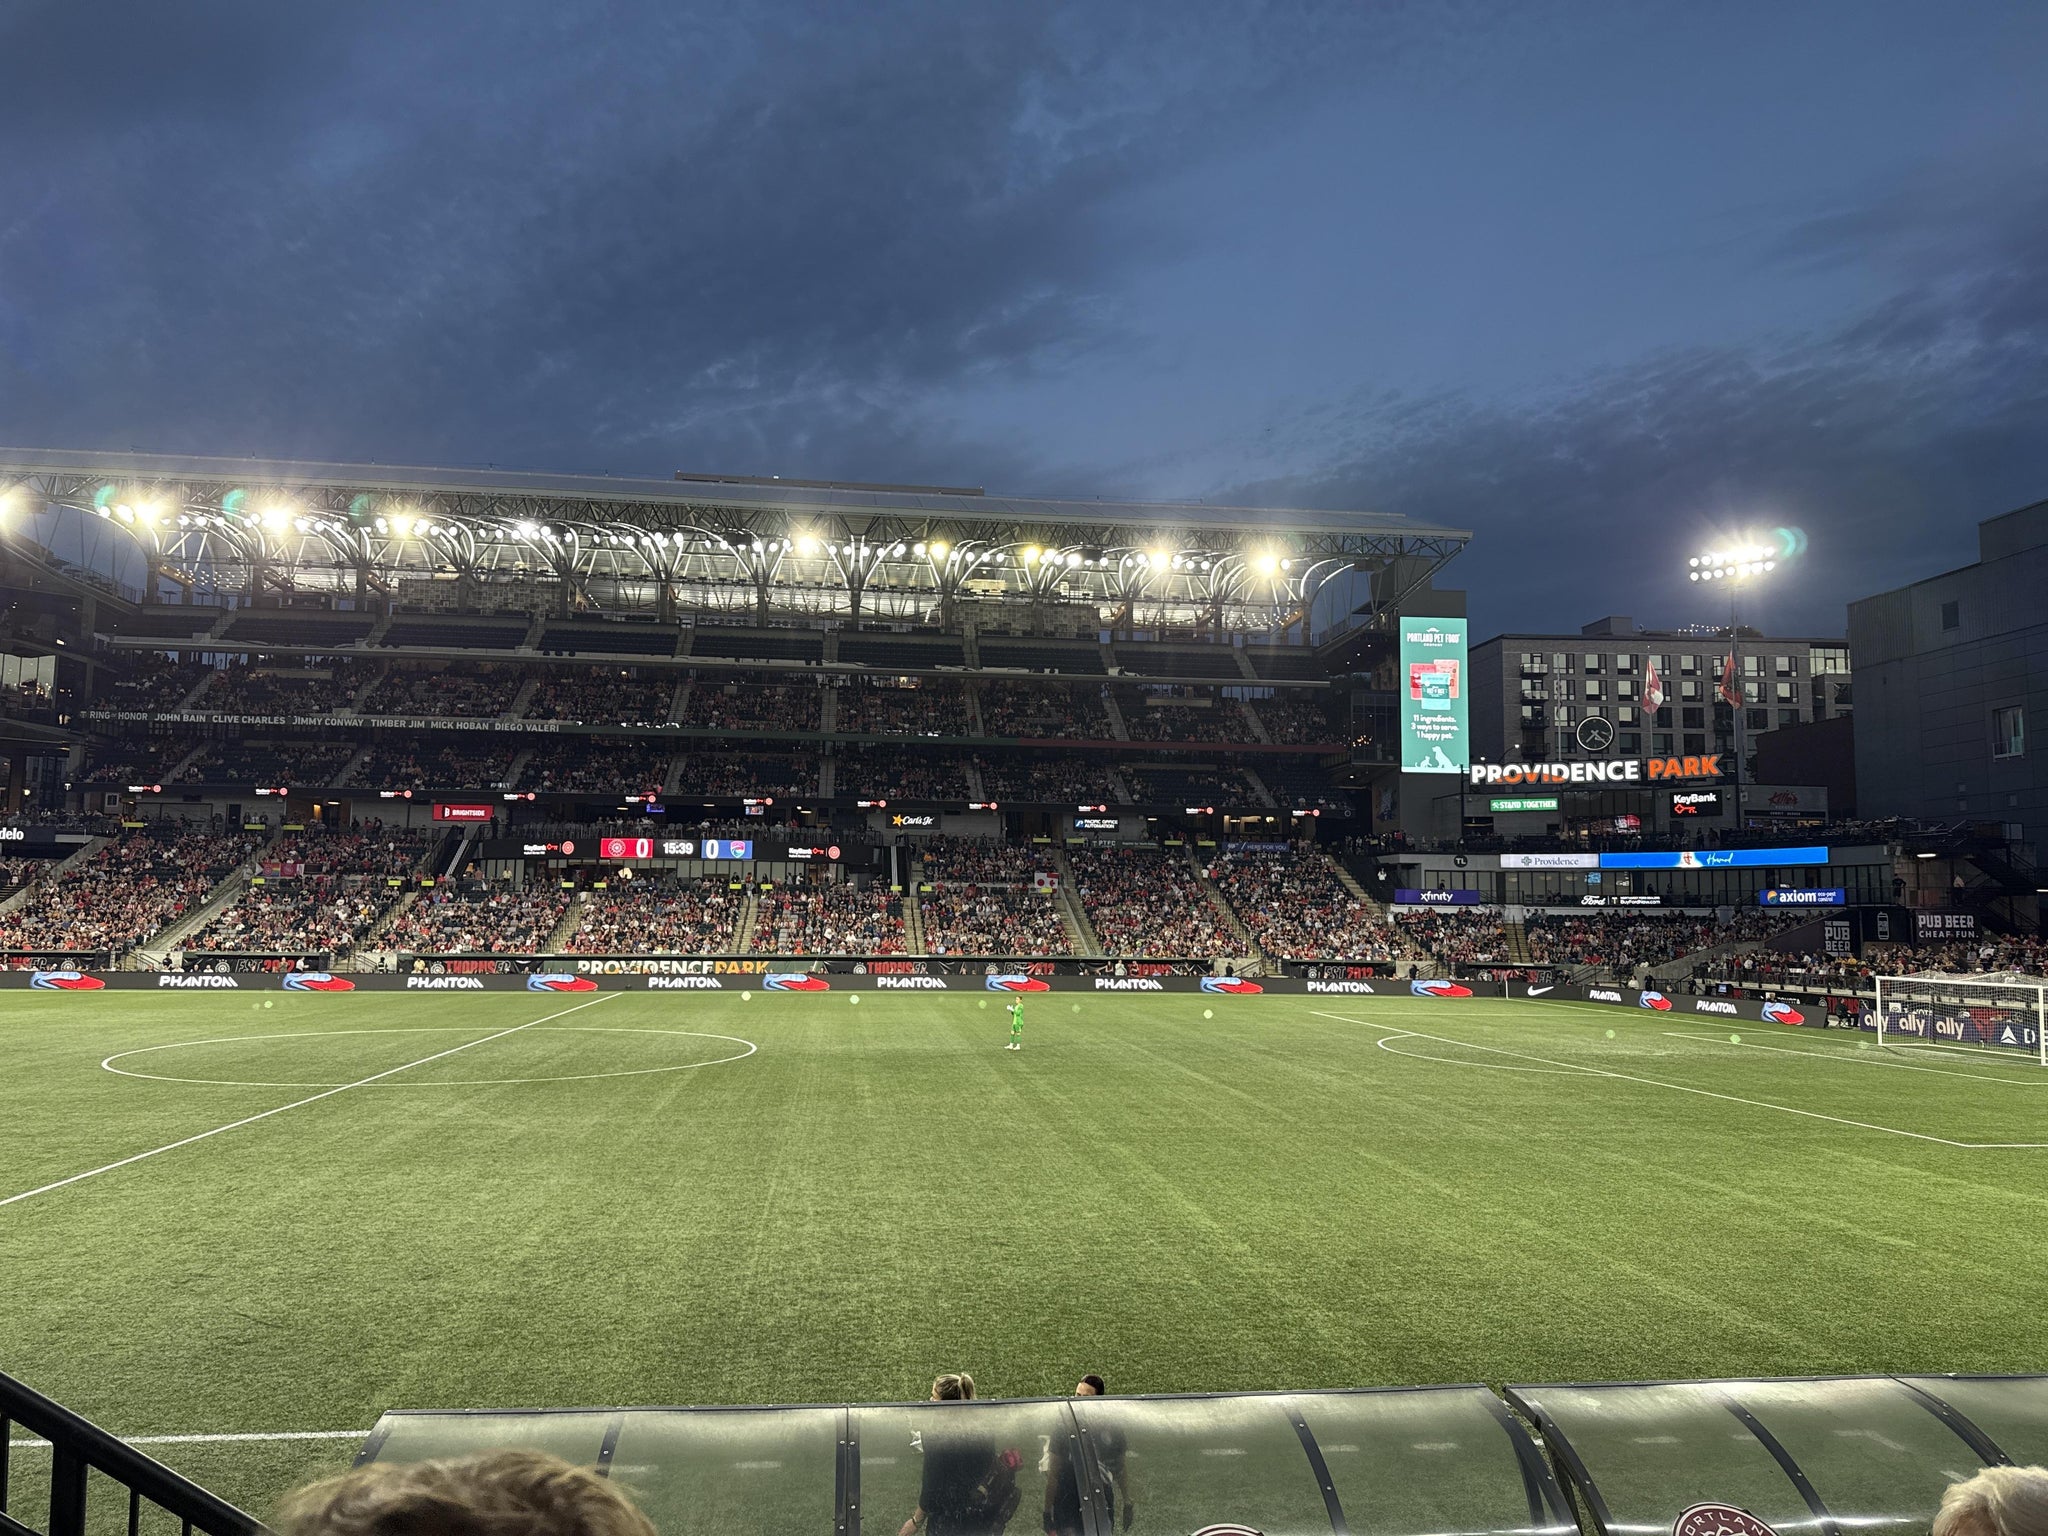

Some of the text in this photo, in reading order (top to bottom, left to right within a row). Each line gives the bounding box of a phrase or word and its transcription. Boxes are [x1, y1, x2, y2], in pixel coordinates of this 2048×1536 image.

[1406, 632, 1433, 643] PORTLAND
[1433, 633, 1444, 643] PET
[89, 711, 110, 720] RING
[117, 712, 148, 721] HONOR
[154, 713, 181, 722] JOHN
[182, 713, 206, 723] BAIN
[212, 715, 240, 724] CLIVE
[241, 715, 286, 725] CHARLES
[292, 716, 323, 726] JIMMY
[324, 717, 364, 727] CONWAY
[370, 719, 406, 728] TIMBER
[408, 720, 425, 729] JIM
[430, 720, 454, 730] MICK
[456, 721, 489, 731] HOBAN
[494, 722, 524, 732] DIEGO
[525, 723, 559, 733] VALERI
[1420, 714, 1456, 724] ingredients.
[1411, 722, 1416, 730] 3
[1421, 731, 1441, 741] happy
[1441, 733, 1454, 741] pet.
[1471, 756, 1720, 784] PROVIDENCE PARK
[1499, 800, 1558, 809] STAND TOGETHER
[1673, 793, 1717, 805] KeyBank
[452, 809, 485, 817] BRIGHTSIDE
[902, 815, 934, 826] Carl's Jr.
[0, 827, 24, 840] delo
[635, 838, 719, 859] 0 15:39 0
[1455, 857, 1467, 865] TL
[1534, 857, 1579, 866] Providence
[1420, 891, 1453, 902] xfinity
[1580, 895, 1606, 906] Ford
[1780, 890, 1817, 902] axiom
[1918, 915, 1974, 928] PUB BEER
[1824, 927, 1850, 940] PUB
[1825, 941, 1851, 951] BEER
[445, 960, 496, 973] THORNS
[578, 961, 771, 975] PROVIDENCE PARK
[1323, 966, 1347, 979] EST
[158, 975, 239, 988] PHANTOM
[407, 976, 484, 989] PHANTOM
[648, 976, 722, 988] PHANTOM
[876, 976, 947, 989] PHANTOM
[1095, 978, 1163, 990] PHANTOM
[1307, 981, 1375, 993] PHANTOM
[1589, 989, 1622, 1002] PHANTOM
[1696, 1000, 1738, 1014] PHANTOM
[1899, 1014, 1926, 1037] ally
[1936, 1017, 1965, 1040] ally
[1684, 1511, 1765, 1536] ORTLAN
